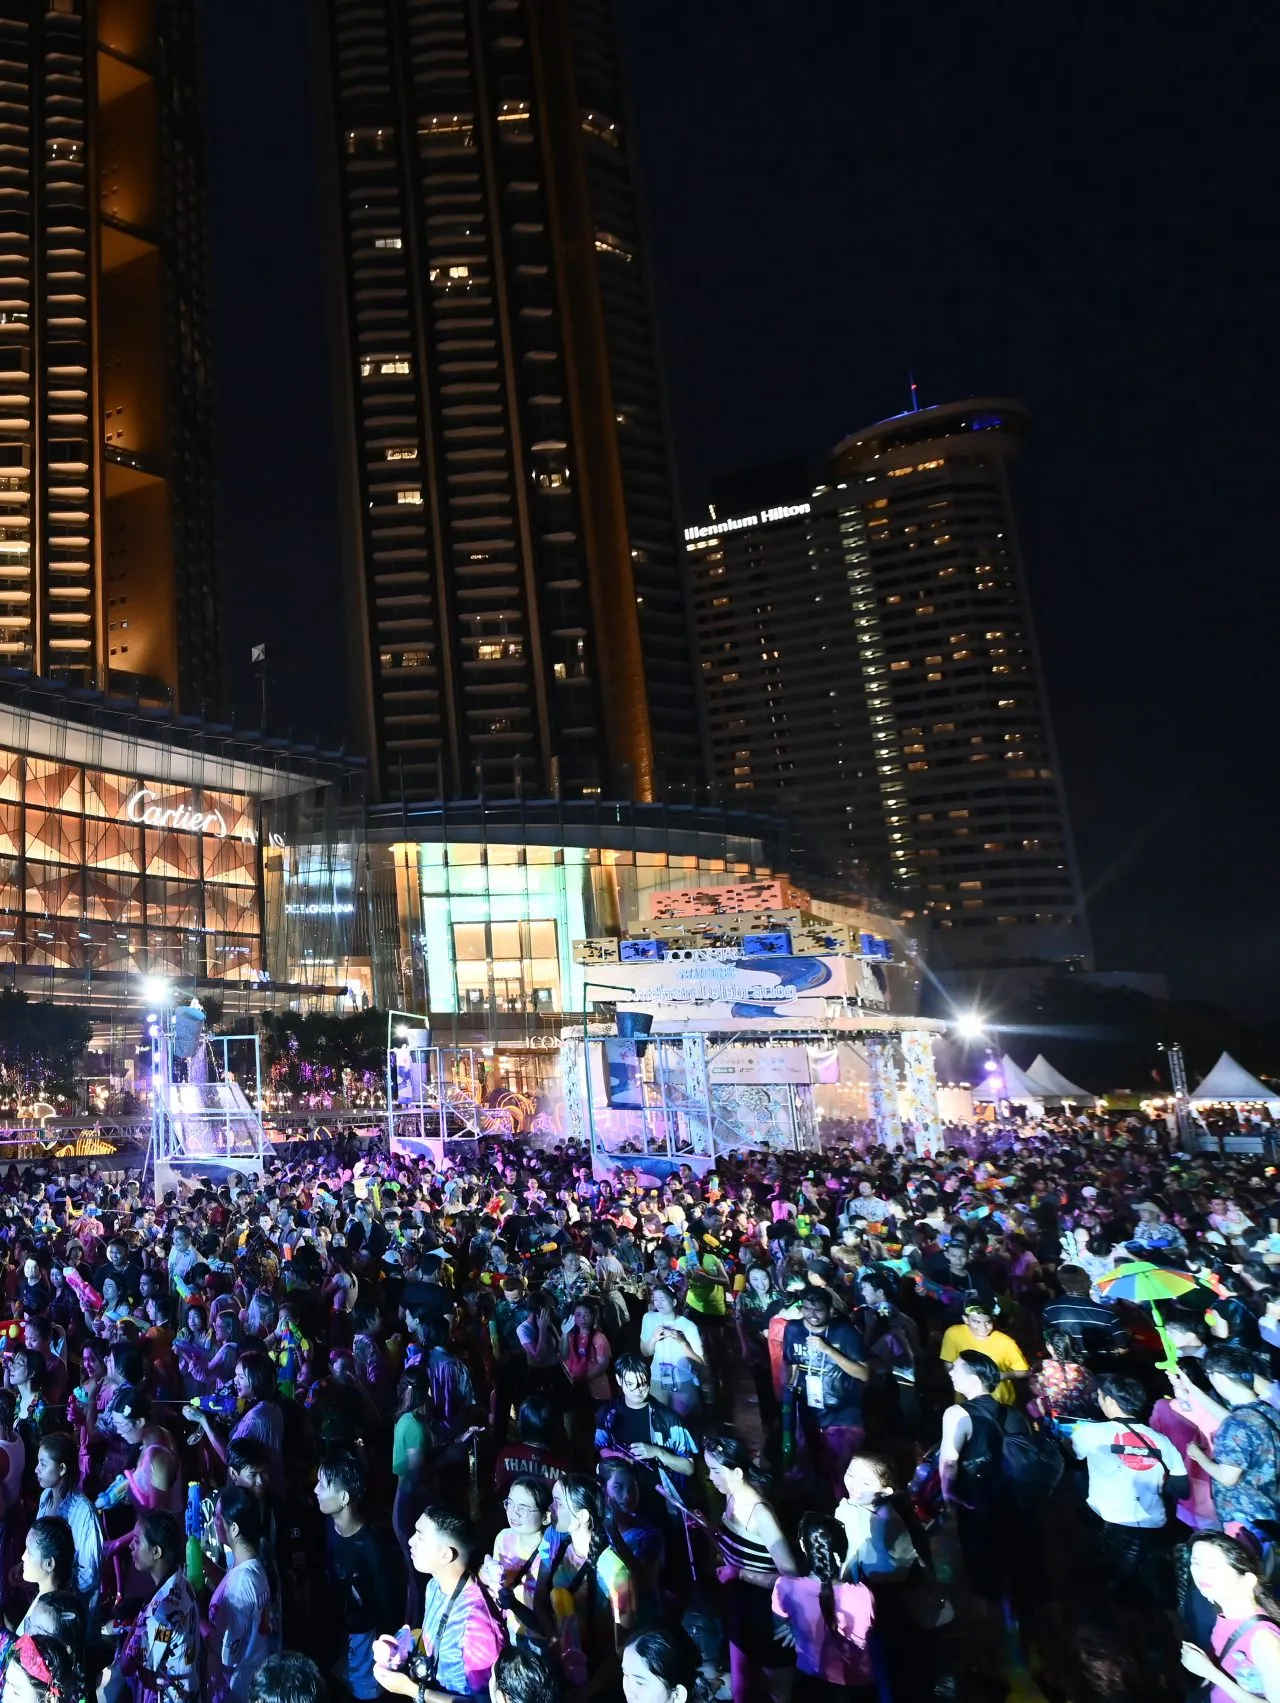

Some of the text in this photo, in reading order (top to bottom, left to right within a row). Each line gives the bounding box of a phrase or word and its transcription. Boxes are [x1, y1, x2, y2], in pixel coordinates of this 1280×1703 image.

[683, 503, 811, 541] illennium Hilton
[127, 789, 219, 834] Cartier
[699, 982, 798, 1001] Celebration
